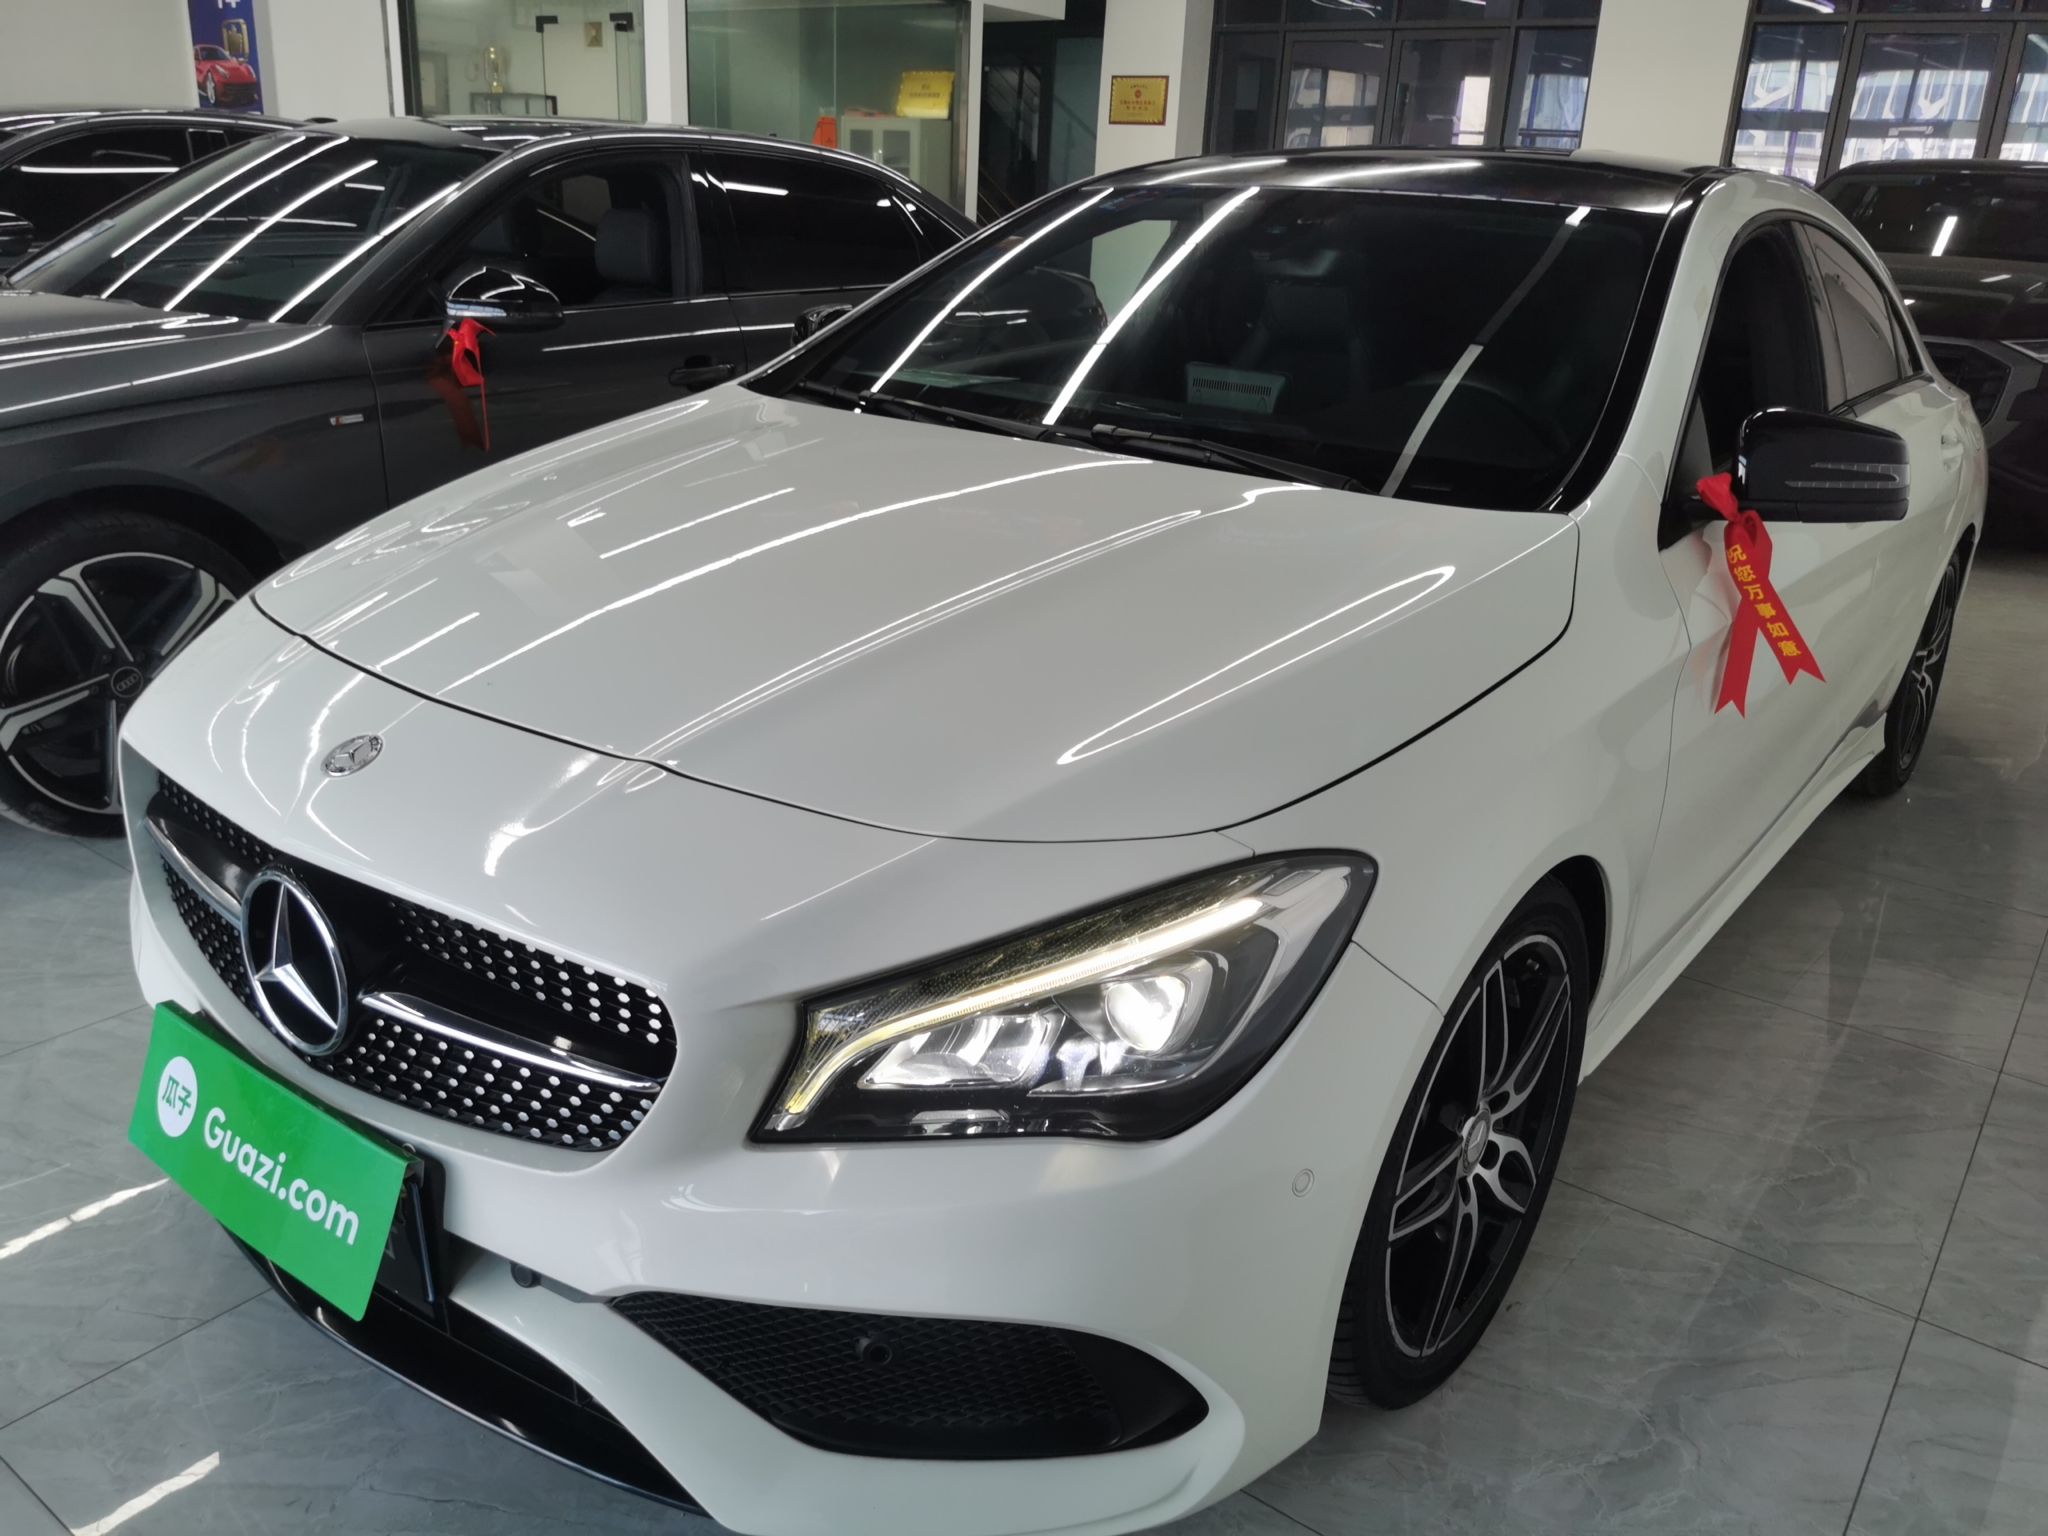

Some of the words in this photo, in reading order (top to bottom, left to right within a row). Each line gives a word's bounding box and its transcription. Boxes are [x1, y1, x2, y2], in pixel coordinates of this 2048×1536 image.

[1726, 544, 1802, 657] 祝您万事如意
[161, 1074, 192, 1116] 瓜子
[203, 1107, 360, 1246] Guazi.com
